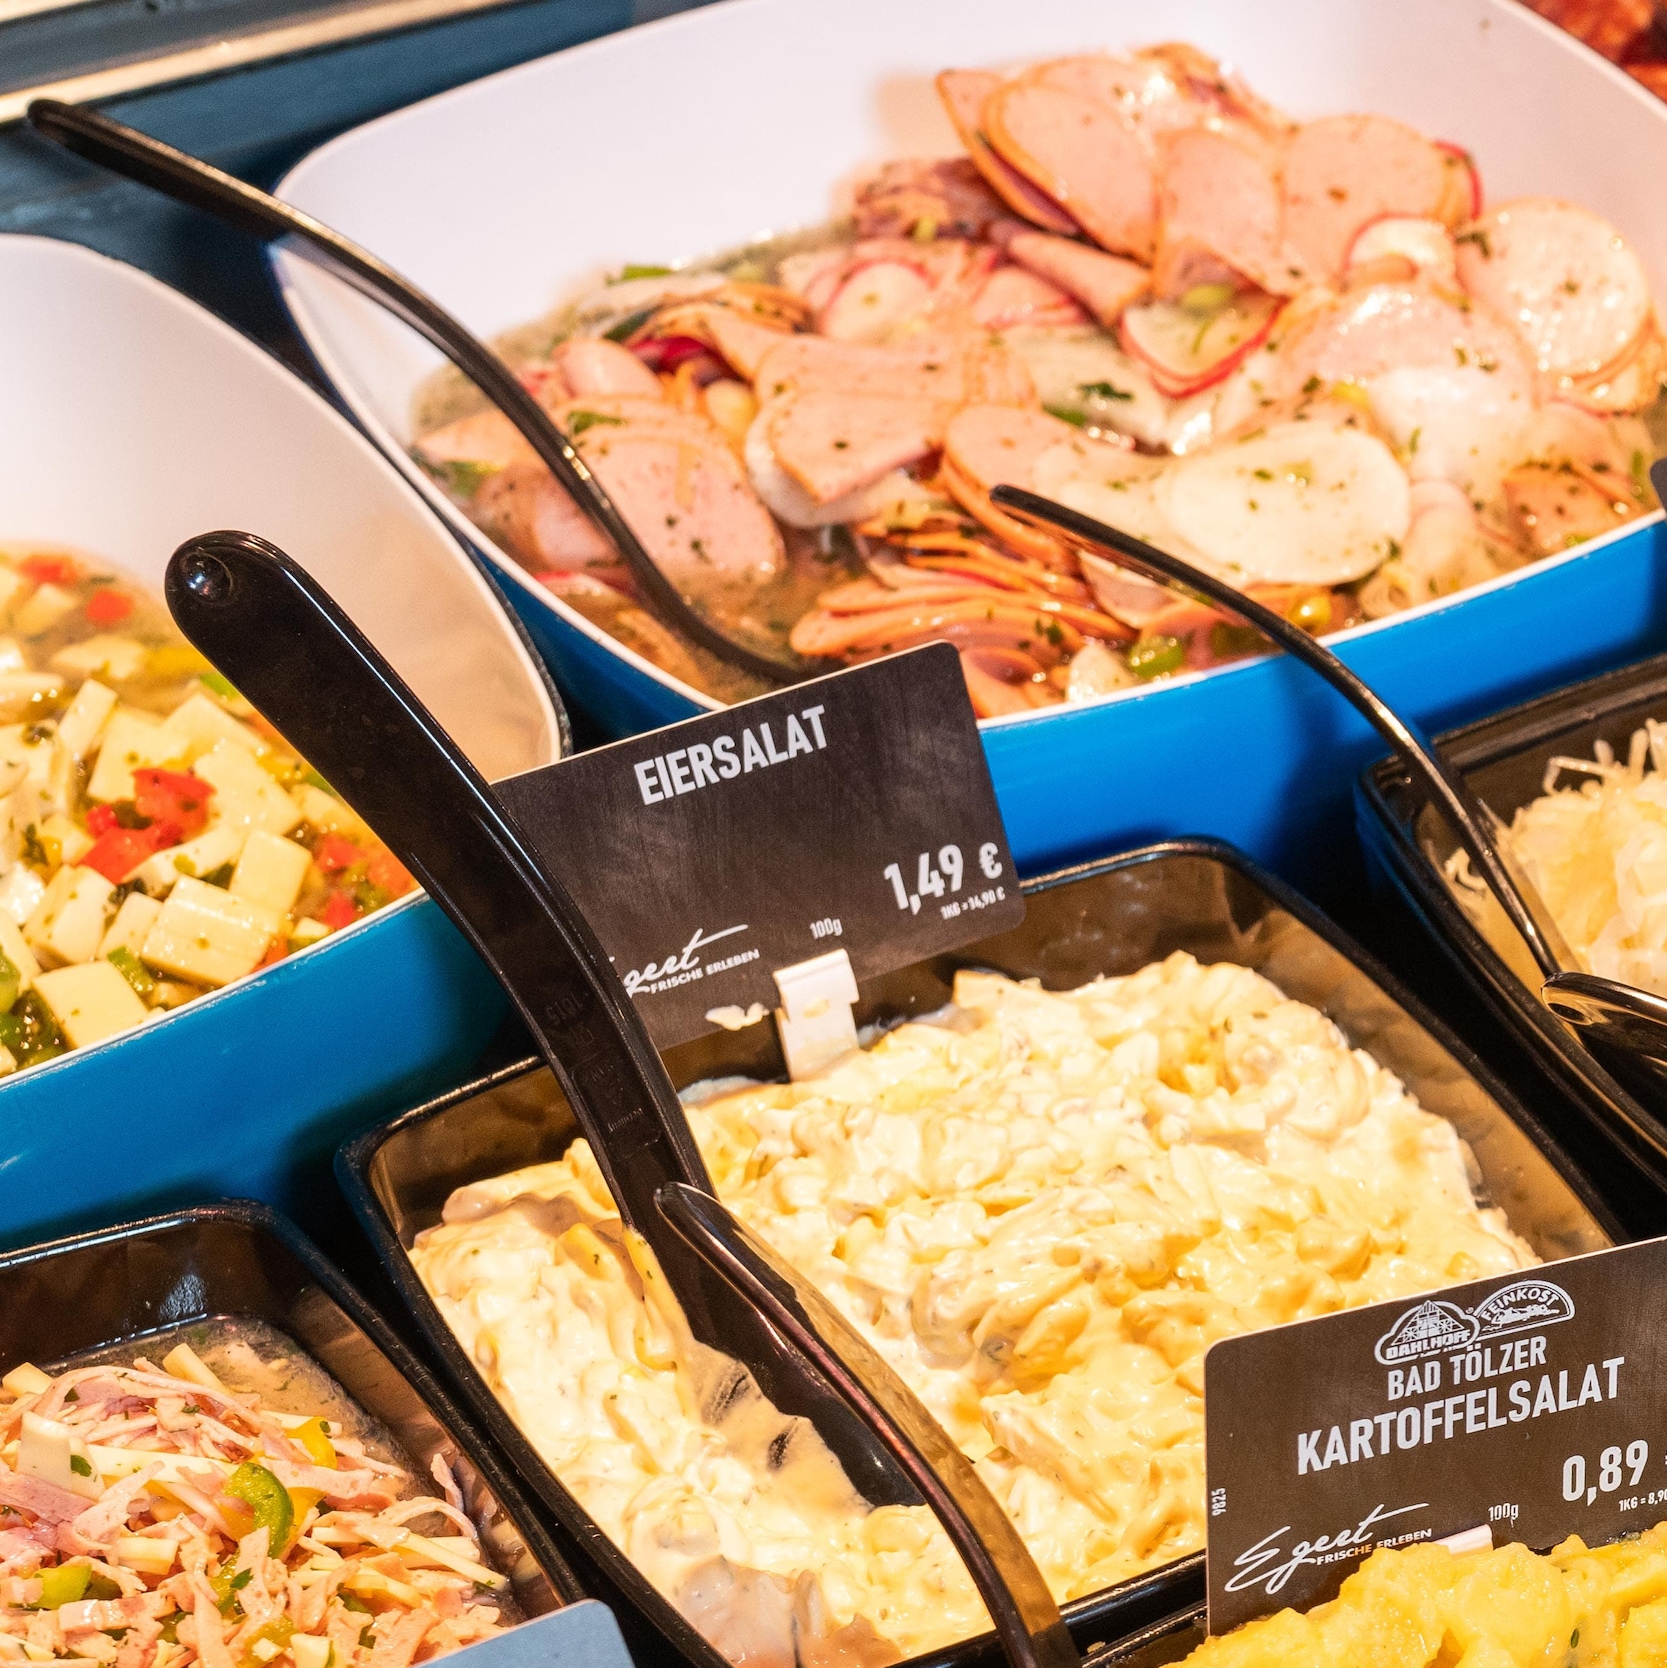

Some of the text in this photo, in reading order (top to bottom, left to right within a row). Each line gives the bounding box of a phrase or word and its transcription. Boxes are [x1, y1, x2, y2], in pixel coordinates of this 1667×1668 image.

[633, 704, 827, 805] EIERSALAT
[883, 842, 1003, 916] 1,49 €
[809, 915, 844, 942] 100g
[609, 924, 749, 999] gert
[649, 947, 761, 995] FRISCHE ERLEBEN
[1481, 1286, 1561, 1322] FEINKOST
[1386, 1330, 1471, 1360] DAHLHOFF
[1387, 1335, 1547, 1401] BAD TÖLZER
[1297, 1356, 1625, 1475] KARTOFFELSALAT
[1562, 1439, 1648, 1506] 0,89
[1212, 1488, 1227, 1516] 9825
[1488, 1501, 1519, 1524] 100g
[1618, 1496, 1638, 1512] 1KG
[1316, 1527, 1432, 1566] FRISCHE ERLEBEN
